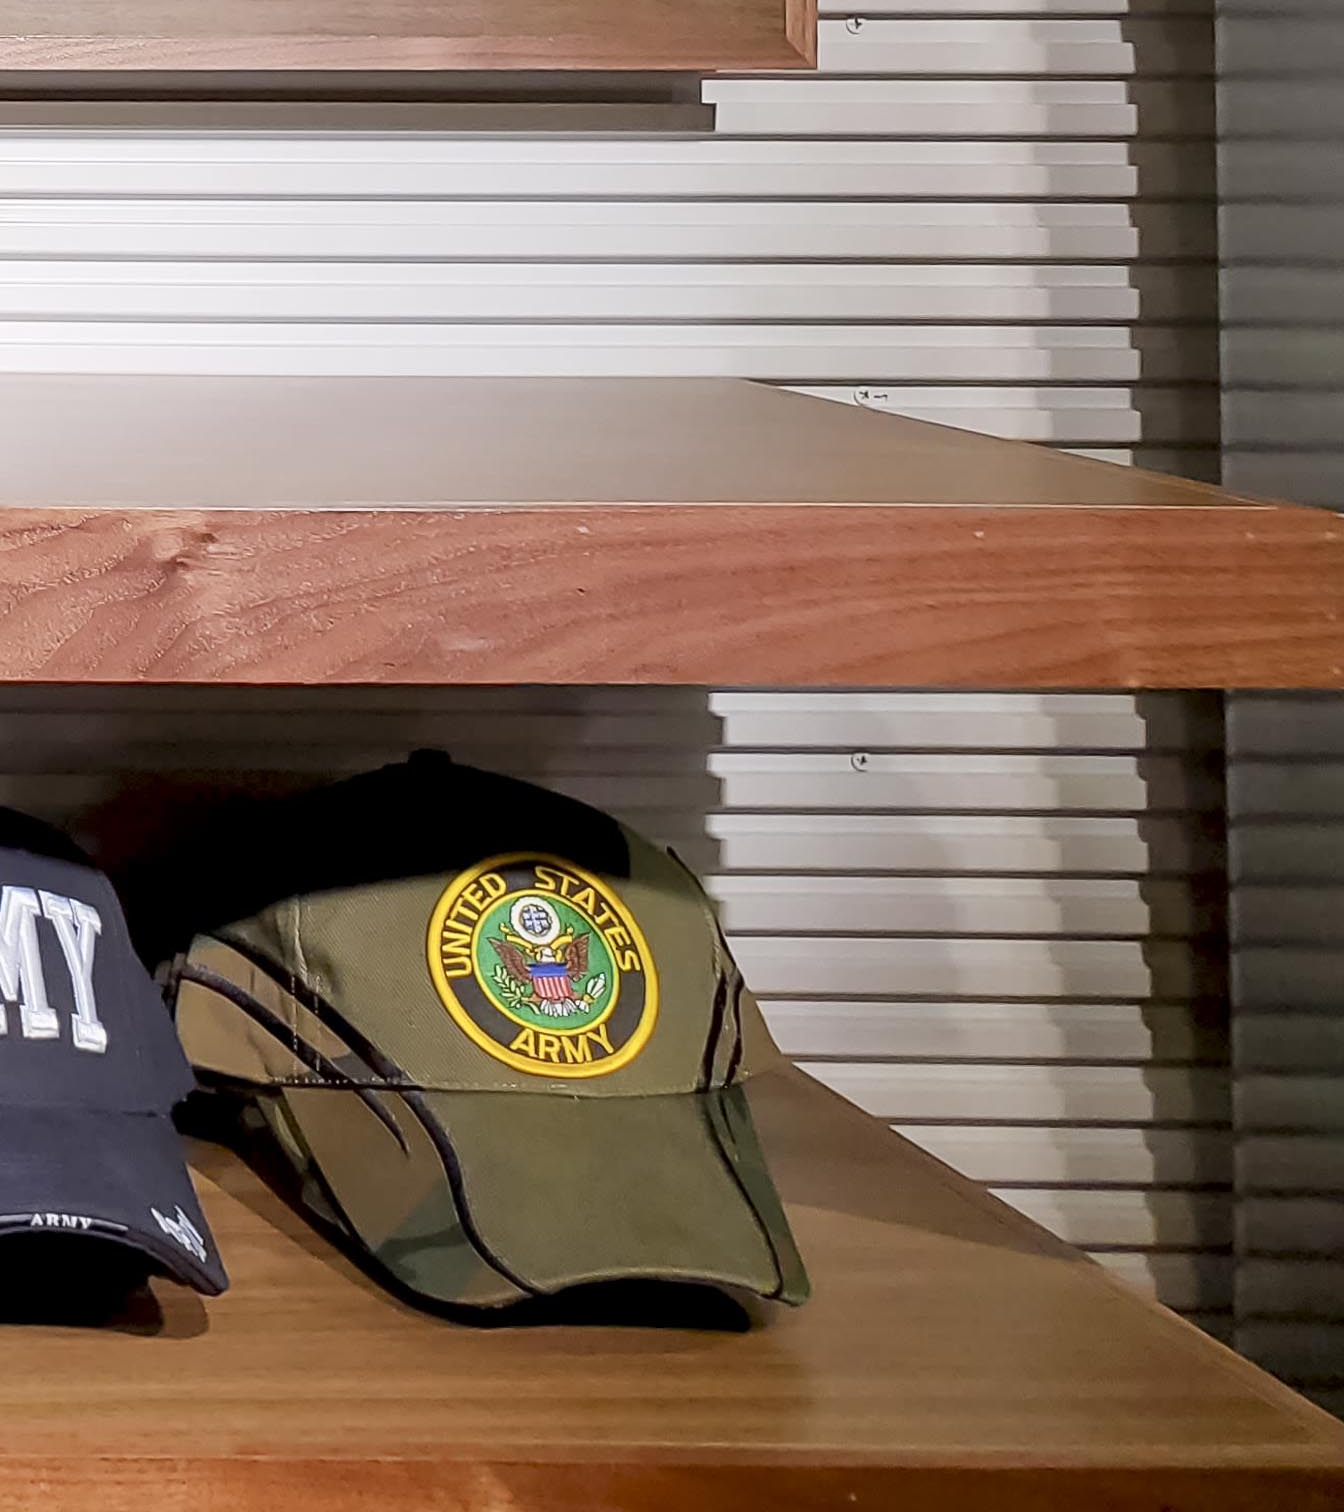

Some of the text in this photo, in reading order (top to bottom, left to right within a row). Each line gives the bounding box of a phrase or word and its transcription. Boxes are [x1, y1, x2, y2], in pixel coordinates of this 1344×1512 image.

[442, 866, 640, 977] UNITED STATES
[510, 1024, 615, 1064] ARMY
[31, 1213, 92, 1229] ARMY
